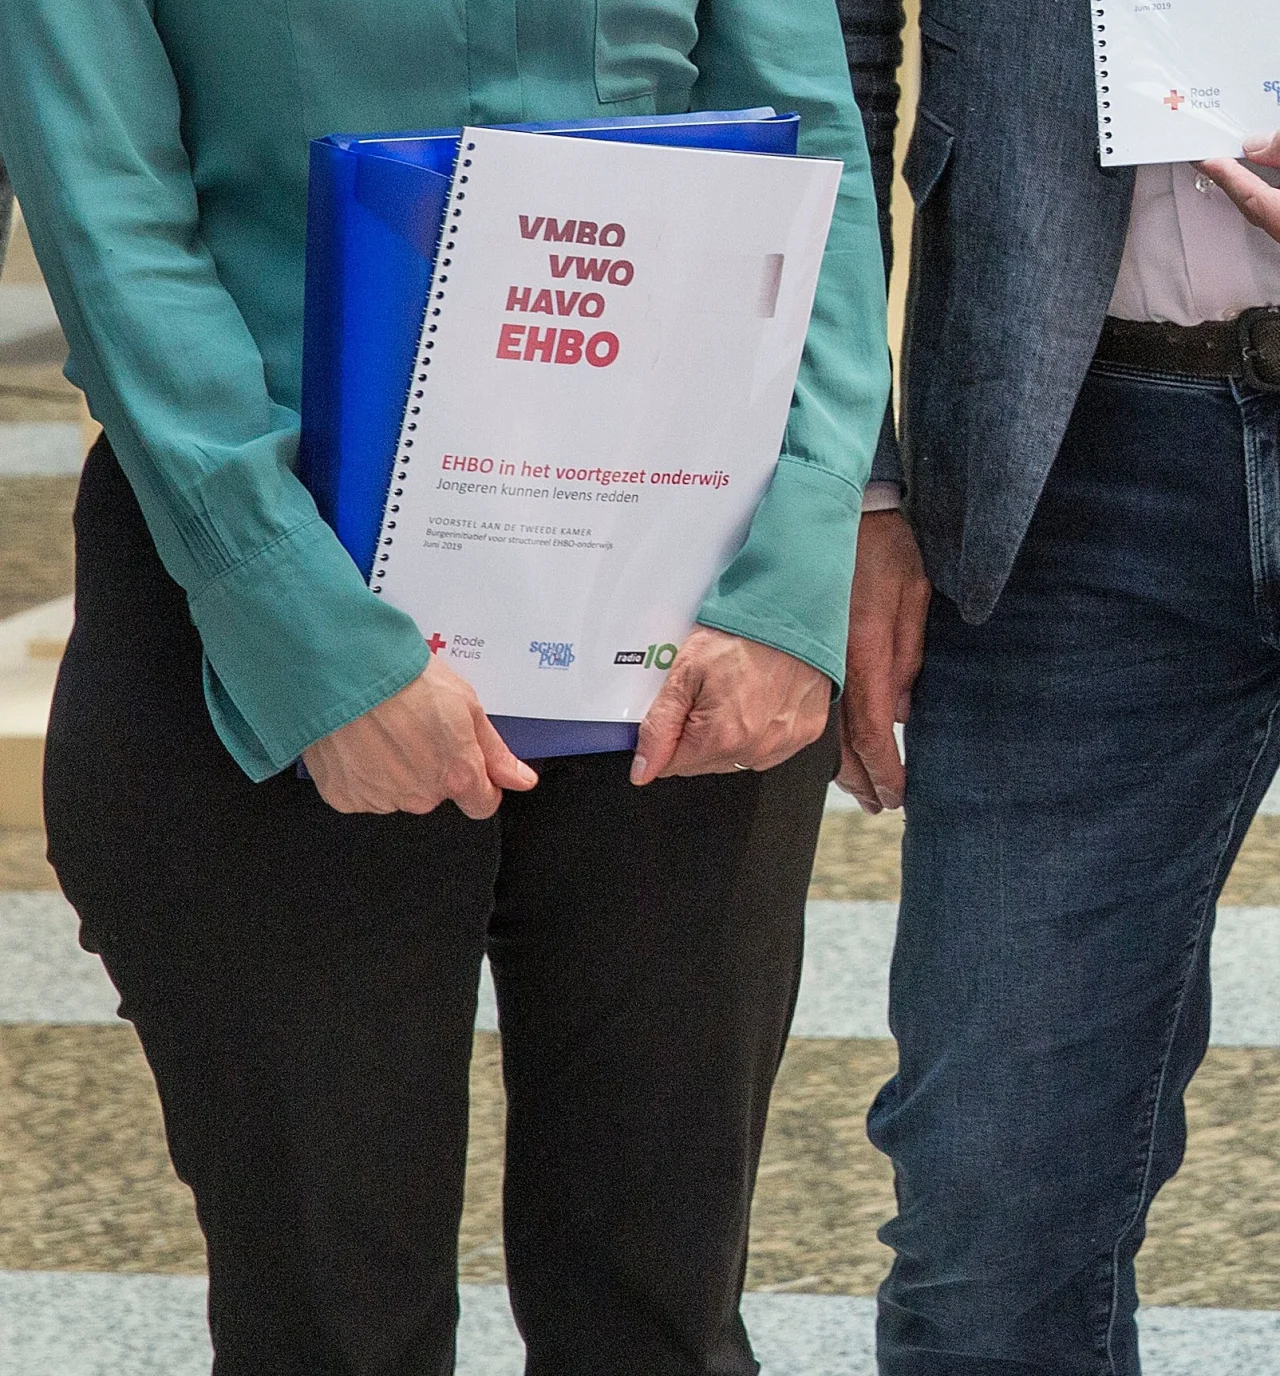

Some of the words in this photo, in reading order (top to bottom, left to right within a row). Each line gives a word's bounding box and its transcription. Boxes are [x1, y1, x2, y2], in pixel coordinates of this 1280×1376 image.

[1152, 2, 1171, 12] 2019
[1190, 87, 1220, 98] Rode
[1191, 98, 1220, 109] Kruis
[518, 215, 626, 248] VMBO
[549, 254, 634, 287] VWO
[505, 286, 605, 318] HAVO
[495, 323, 620, 367] EHBO
[442, 454, 494, 474] EHBO
[499, 459, 515, 476] in
[521, 460, 551, 479] het
[555, 466, 647, 485] voortgezet
[650, 469, 730, 490] onderwijs
[436, 478, 497, 495] Jongeren
[501, 484, 549, 499] kunnen
[552, 487, 593, 502] levens
[596, 490, 639, 504] redden
[429, 516, 477, 529] VOORSTEL
[481, 522, 501, 531] AAN
[504, 523, 516, 532] DE
[520, 524, 557, 535] TWEEDE
[560, 528, 592, 537] KAMER
[423, 540, 440, 549] Juni
[441, 541, 463, 551] 2019
[488, 535, 506, 543] voor
[453, 634, 485, 648] Rode
[450, 647, 481, 660] Kruis
[616, 652, 642, 664] radio
[644, 643, 678, 671] 10
